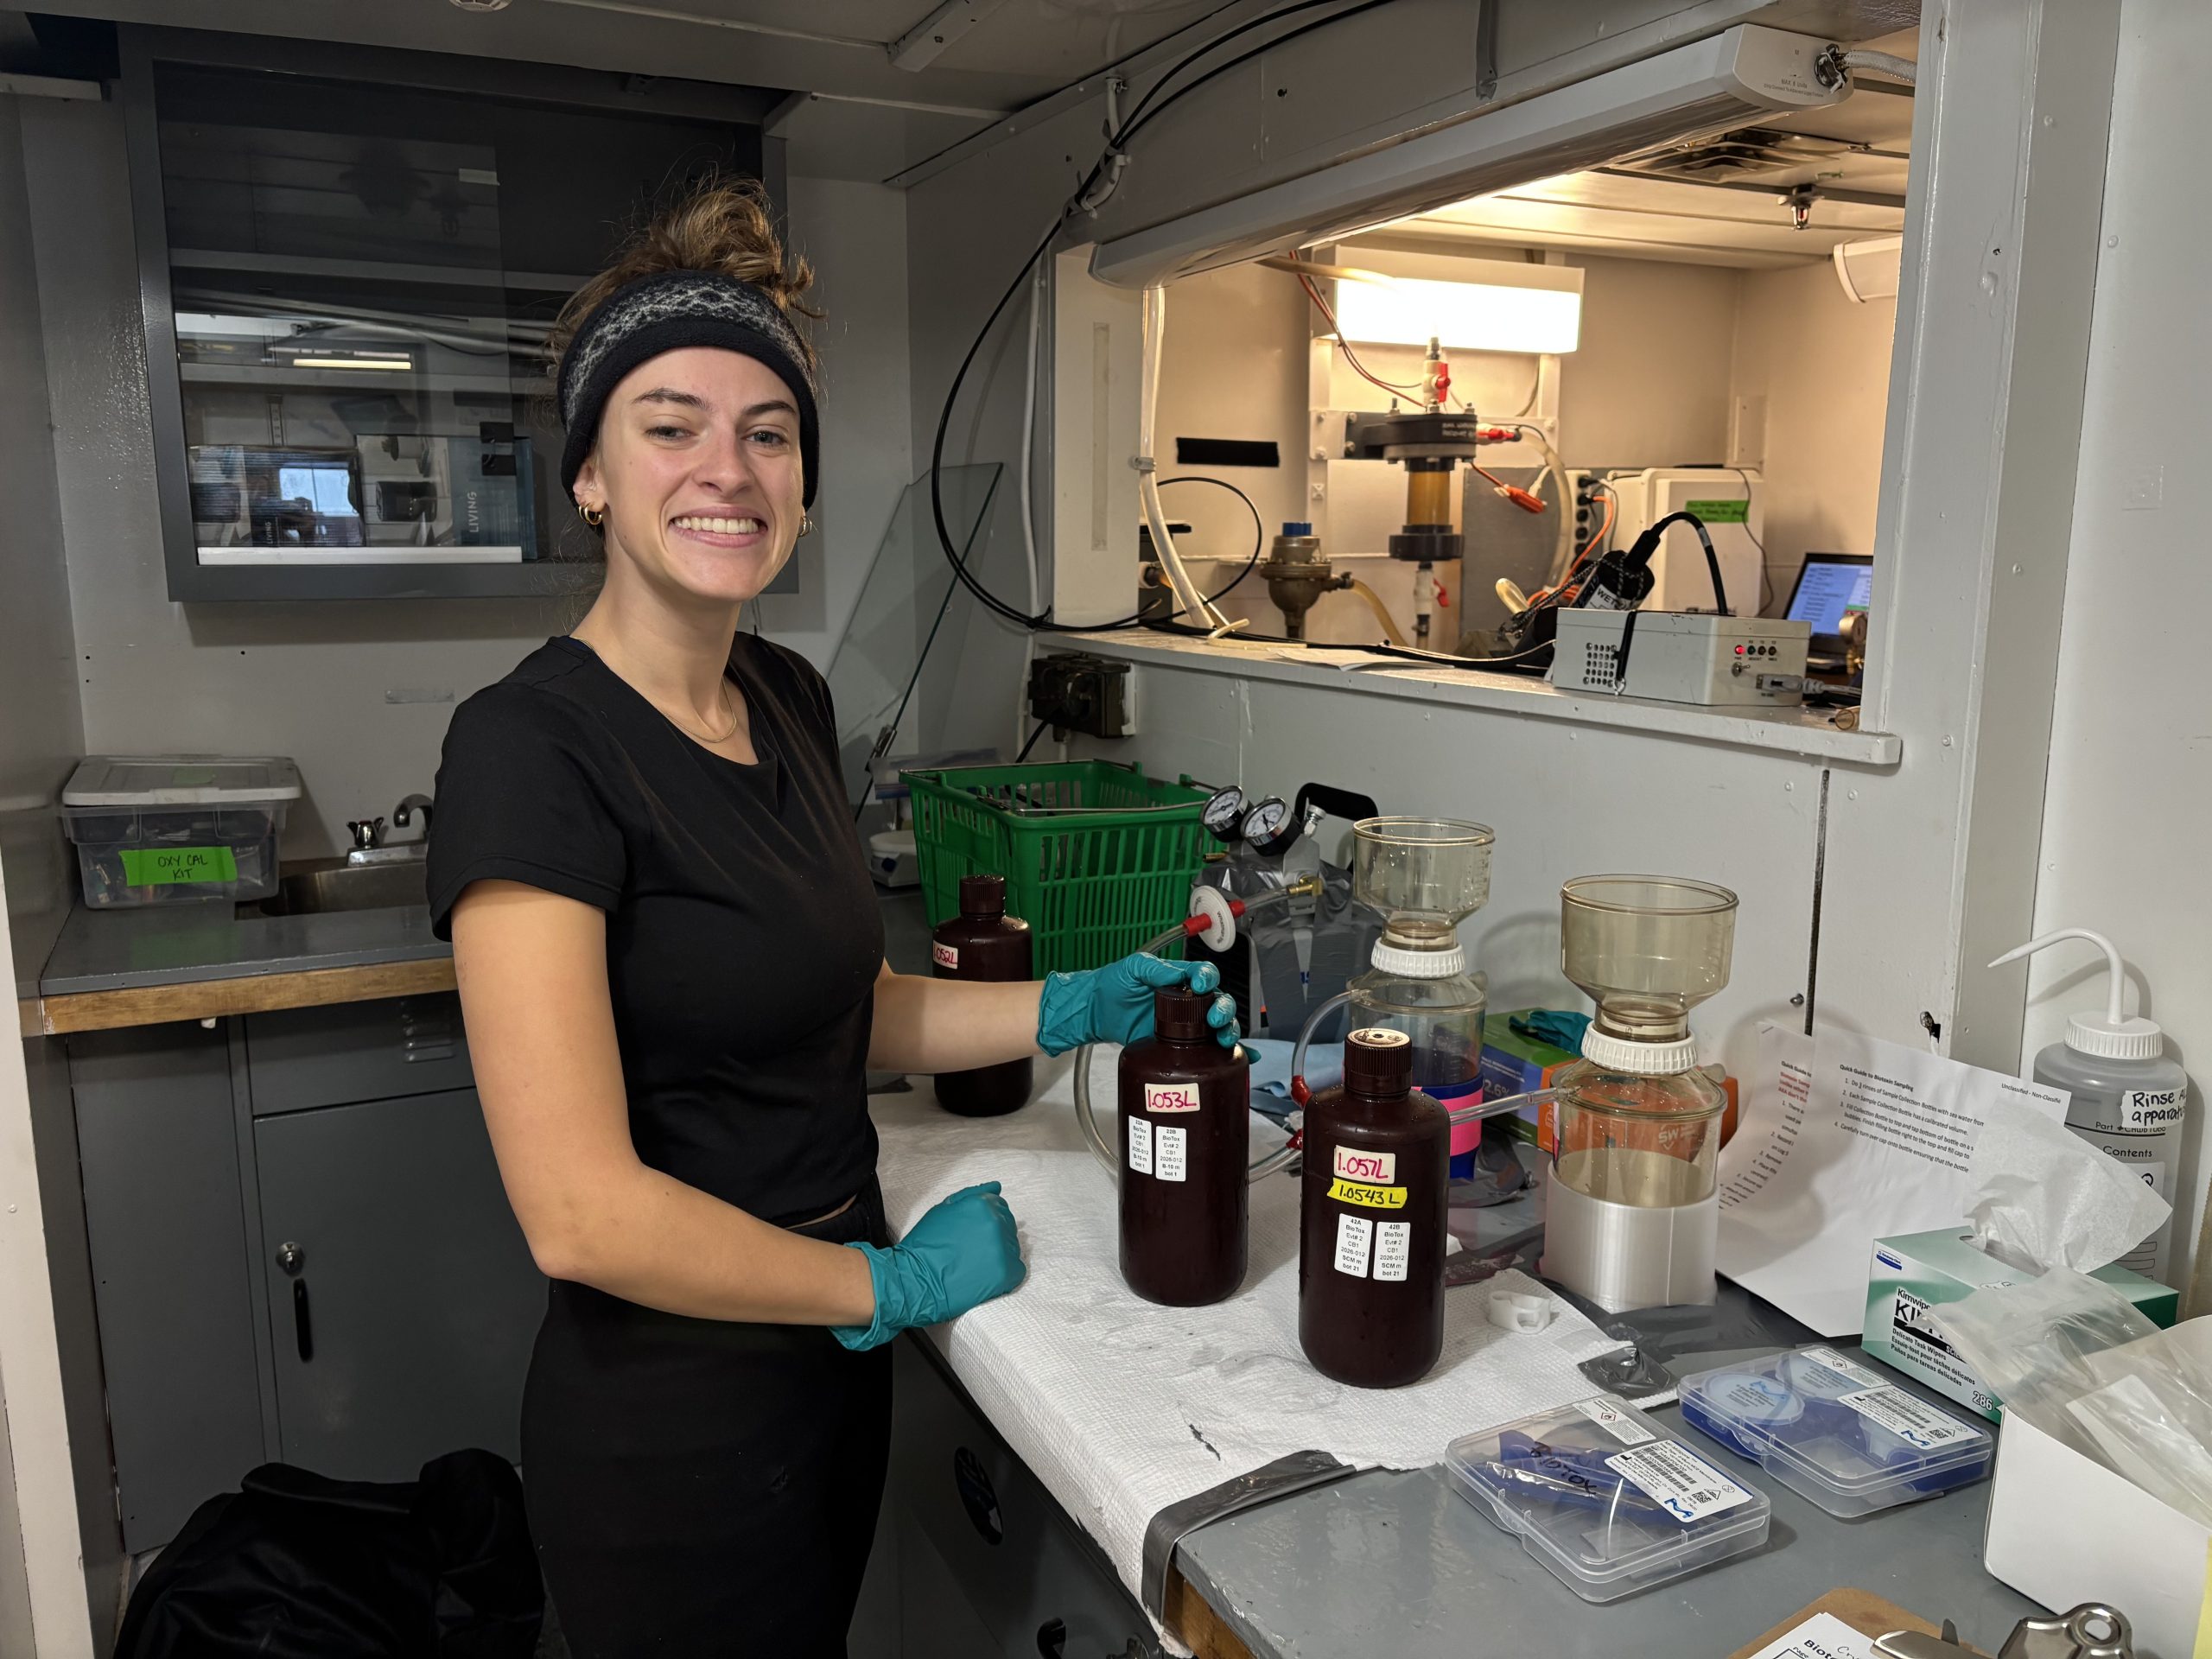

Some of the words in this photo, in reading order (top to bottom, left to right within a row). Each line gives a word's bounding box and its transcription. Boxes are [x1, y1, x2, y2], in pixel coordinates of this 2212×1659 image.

[470, 491, 479, 533] LIVING
[157, 855, 181, 868] OXY
[187, 855, 207, 865] CAL
[173, 868, 193, 880] KIT
[1853, 1068, 1867, 1077] Guide
[1874, 1074, 1893, 1084] Biotoxin
[1894, 1080, 1914, 1092] Sampling
[2001, 1083, 2029, 1095] Unclassified
[1147, 1090, 1197, 1109] 1.053L
[1863, 1084, 1876, 1092] rinses
[1882, 1090, 1898, 1100] Sample
[1898, 1095, 1921, 1107] Collection
[1921, 1102, 1937, 1112] Bottles
[1958, 1115, 1973, 1123] water
[2133, 1091, 2175, 1108] Rinse
[1849, 1091, 1859, 1100] Each
[1860, 1096, 1876, 1105] Sample
[1877, 1101, 1897, 1113] Collection
[1898, 1108, 1912, 1117] Bottle
[1924, 1117, 1948, 1129] calibrated
[1948, 1126, 1968, 1135] volume.
[1853, 1106, 1875, 1117] Collection
[1874, 1112, 1888, 1122] Bottle
[1919, 1128, 1936, 1138] bottom
[1943, 1136, 1959, 1147] bottle
[1862, 1117, 1875, 1127] Finish
[1875, 1122, 1888, 1132] filling
[1888, 1127, 1901, 1135] bottle
[1901, 1132, 1912, 1141] right
[2095, 1122, 2113, 1131] Part
[1840, 1123, 1859, 1135] Carefully
[1898, 1144, 1913, 1154] bottle
[1913, 1150, 1935, 1162] ensuring
[1934, 1156, 1945, 1165] that
[1953, 1163, 1969, 1173] bottle
[2102, 1146, 2153, 1158] Contents
[1338, 1152, 1389, 1179] 1.057L
[1339, 1184, 1384, 1205] 1.0543
[1389, 1193, 1401, 1204] L
[1345, 1224, 1365, 1234] BioTox
[1340, 1246, 1366, 1257] 2026-012
[1342, 1255, 1356, 1263] SCM
[1892, 1327, 1914, 1344] Delicate
[1914, 1338, 1927, 1351] Task
[1927, 1345, 1947, 1361] Wipers
[1891, 1335, 1920, 1357] Essuie-tout
[1920, 1351, 1933, 1363] pour
[1933, 1357, 1951, 1372] tâches
[1951, 1366, 1975, 1385] délicates
[1891, 1343, 1906, 1357] Paños
[1906, 1351, 1919, 1363] para
[1919, 1357, 1936, 1372] tareas
[1937, 1368, 1962, 1387] delicadas
[1972, 1390, 1993, 1411] 286
